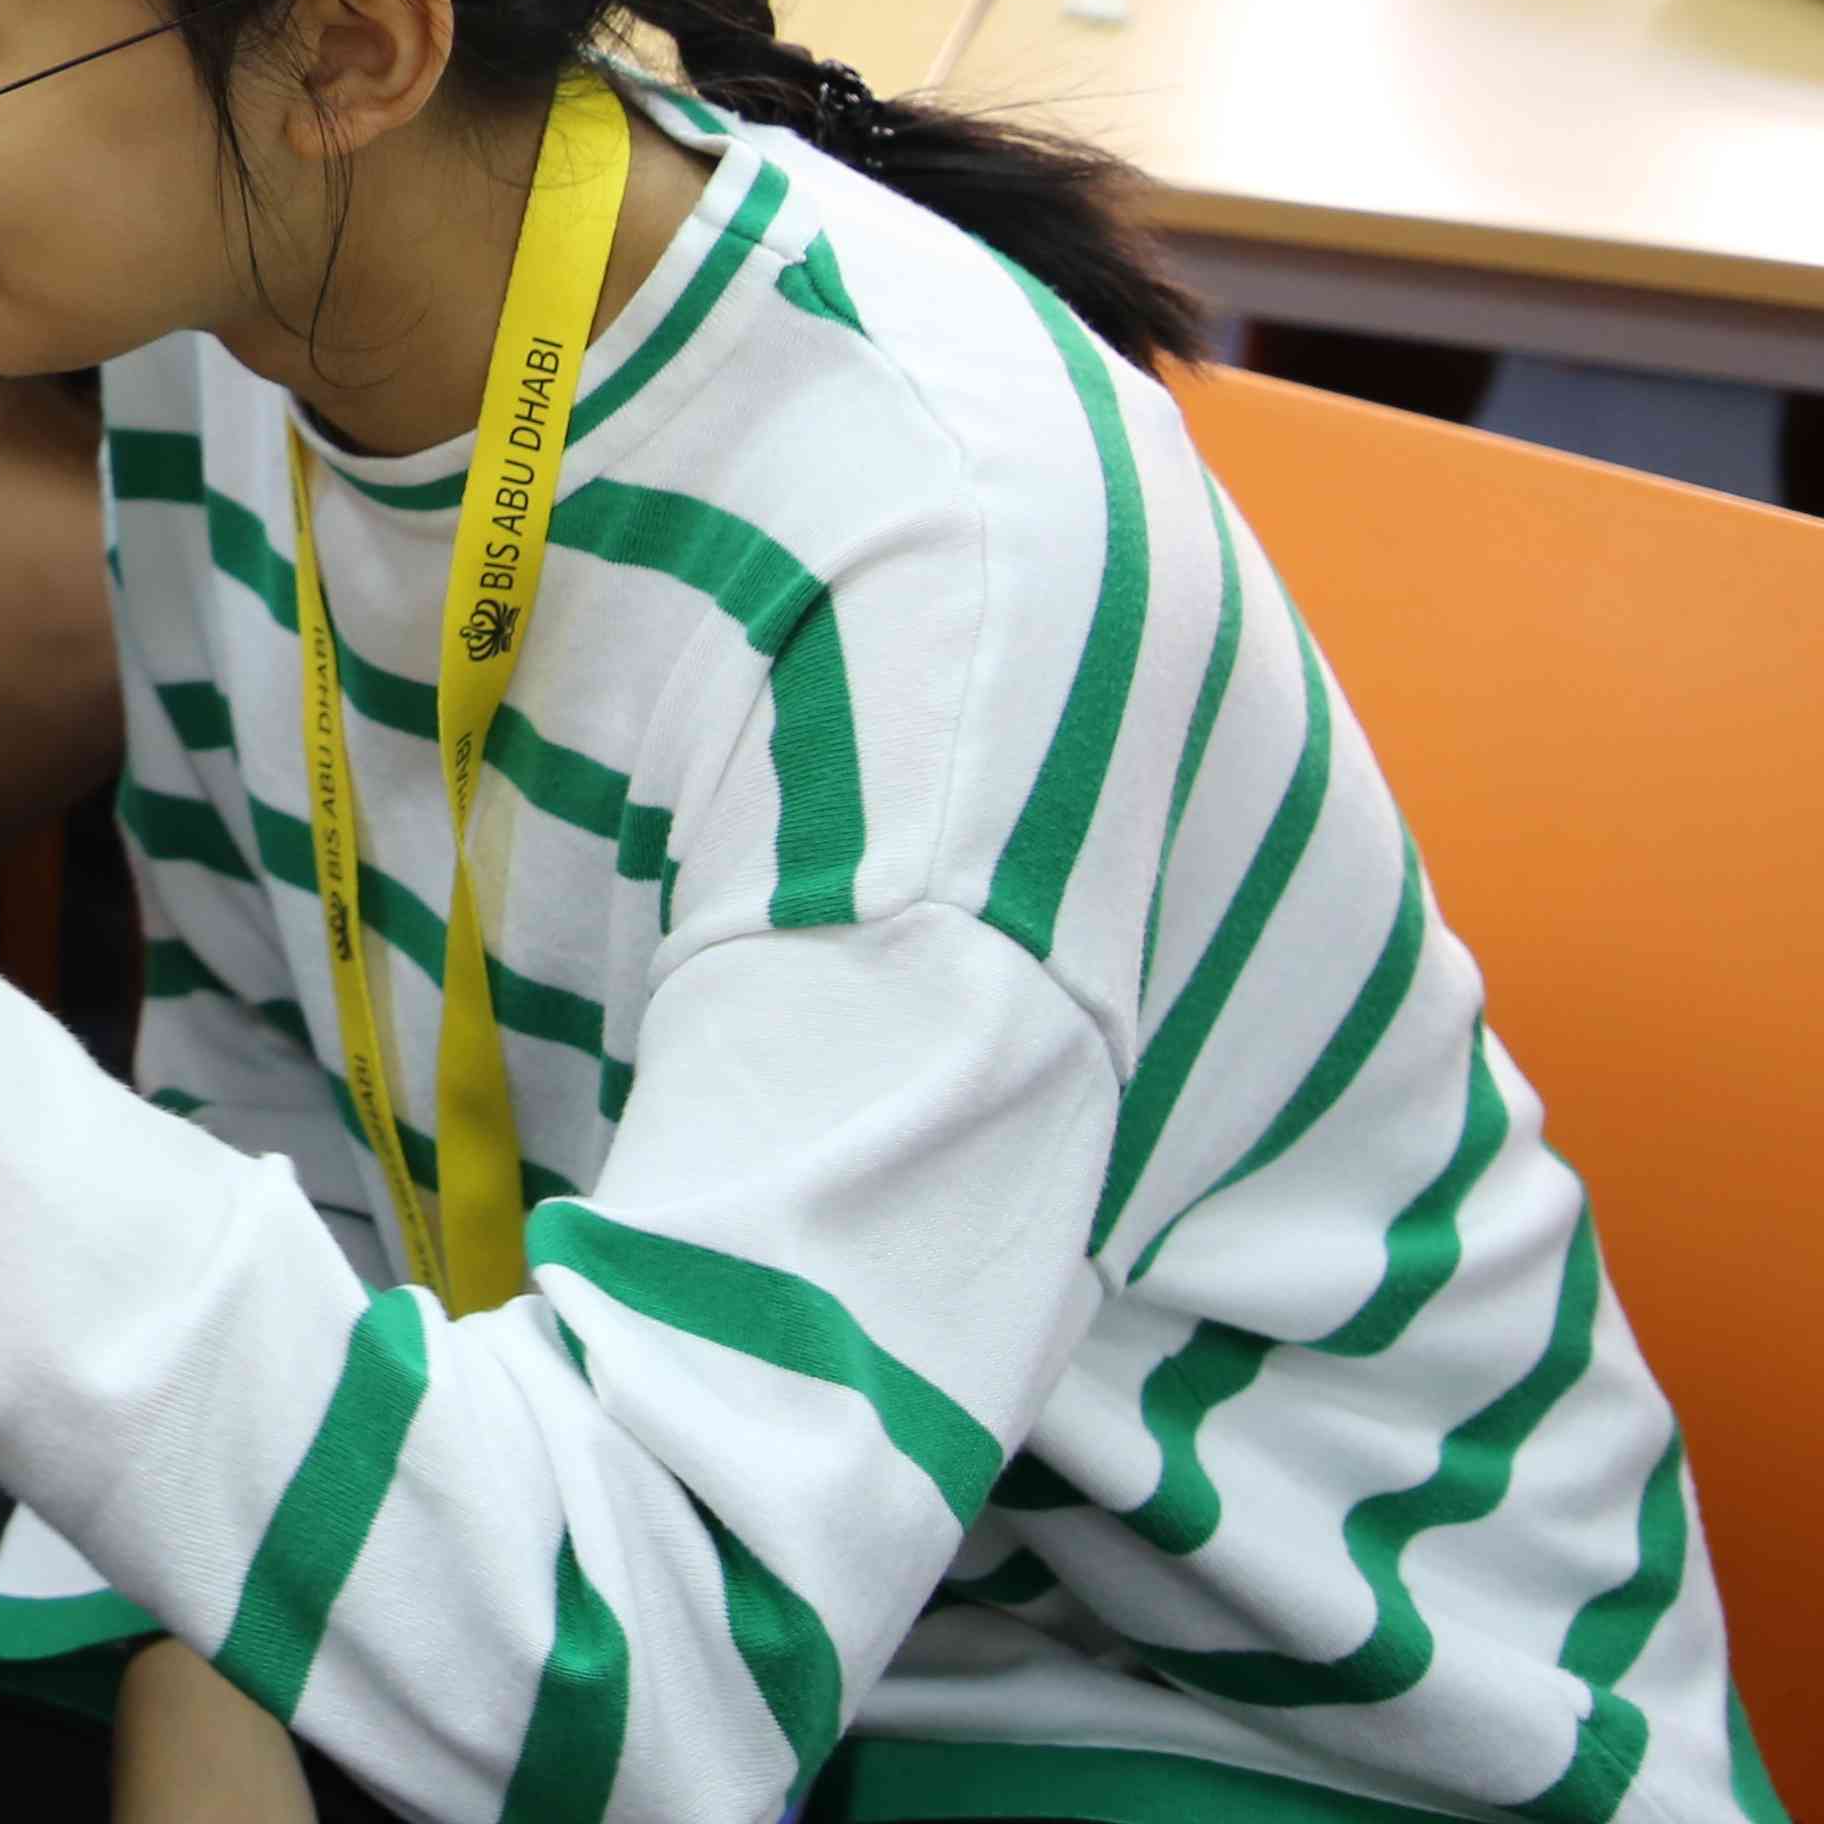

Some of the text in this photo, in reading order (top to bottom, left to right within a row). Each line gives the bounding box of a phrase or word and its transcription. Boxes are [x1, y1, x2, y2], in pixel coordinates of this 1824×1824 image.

[479, 337, 563, 590] BIS ABU DHABI
[313, 624, 343, 881] BIS ABU DHABI
